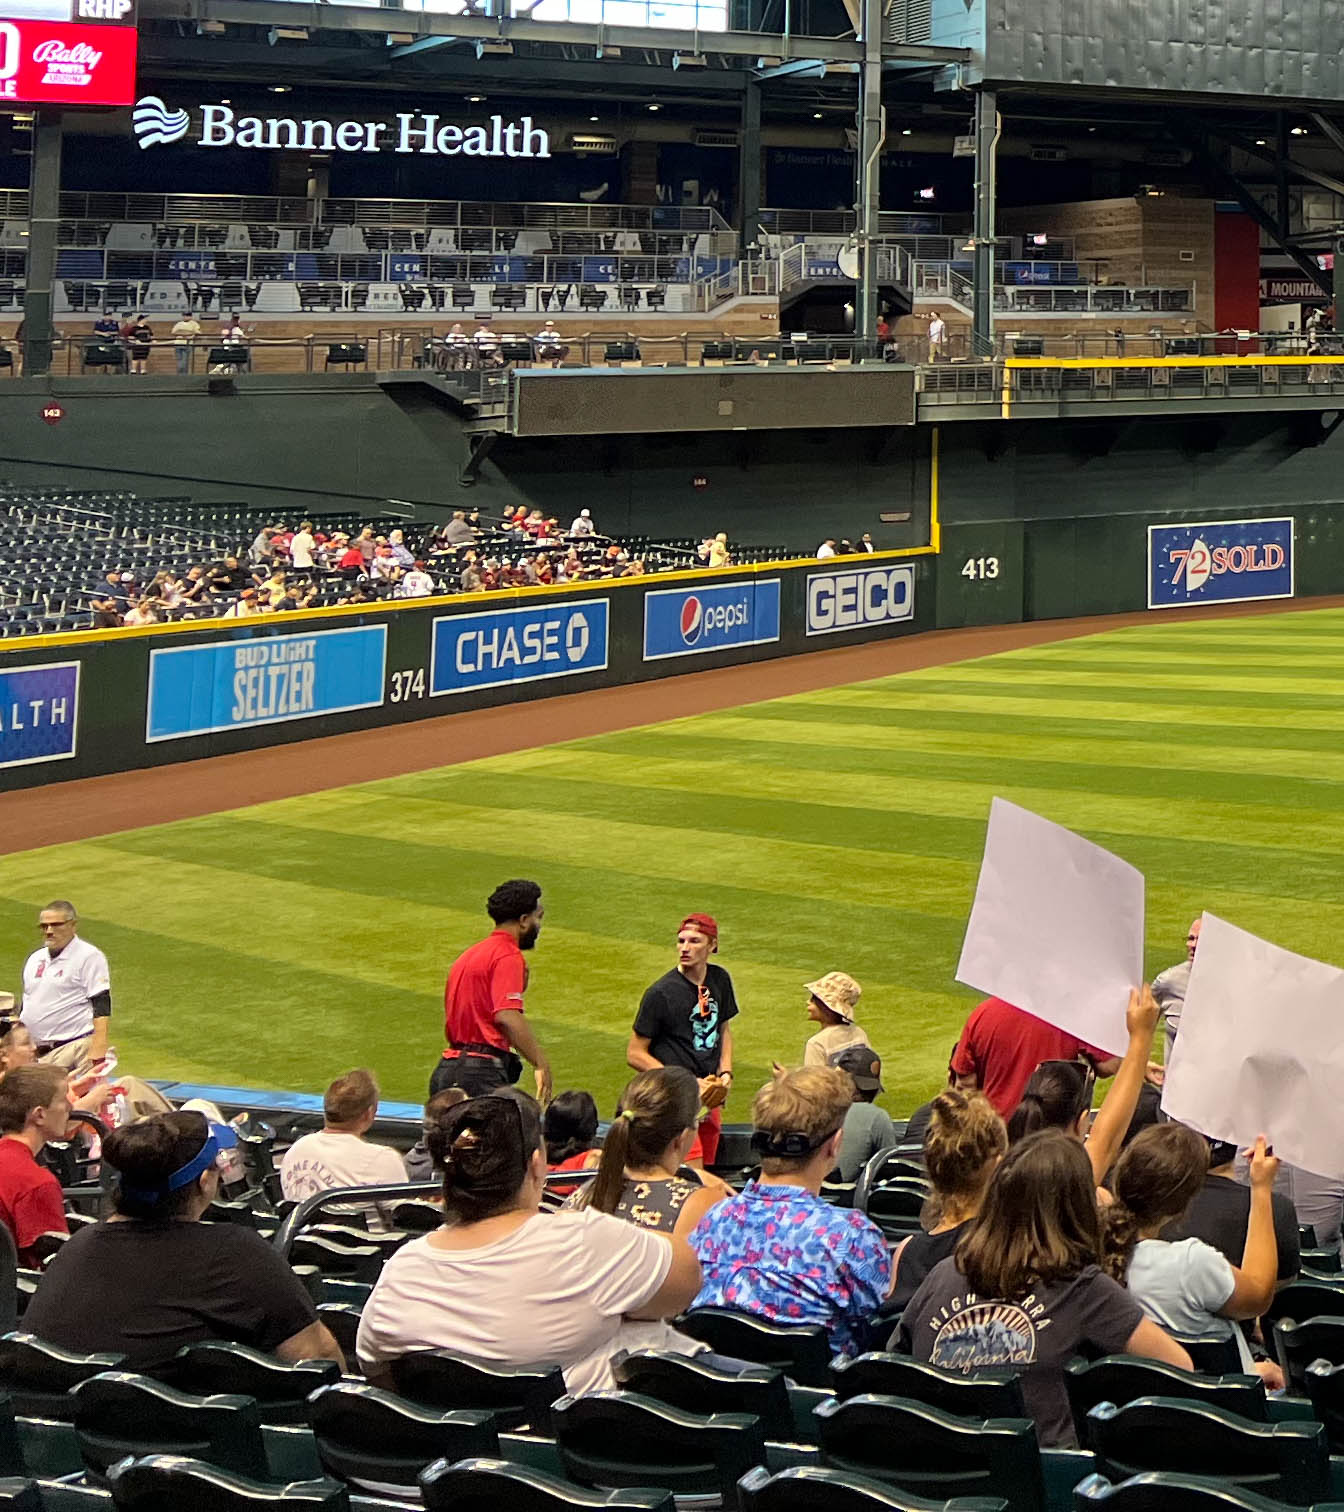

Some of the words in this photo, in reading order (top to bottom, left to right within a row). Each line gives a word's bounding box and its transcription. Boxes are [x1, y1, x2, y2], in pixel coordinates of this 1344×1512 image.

[33, 40, 103, 70] Bally
[198, 104, 386, 152] Banner
[395, 113, 551, 158] Health
[962, 557, 999, 580] 413
[704, 597, 749, 637] pepsi
[809, 568, 914, 630] GEICO
[235, 645, 267, 667] BUD
[271, 640, 316, 664] LIGHT
[456, 620, 561, 674] CHASE
[232, 661, 315, 722] SELTZER
[391, 669, 426, 703] 374
[929, 1293, 976, 1331] HIGH
